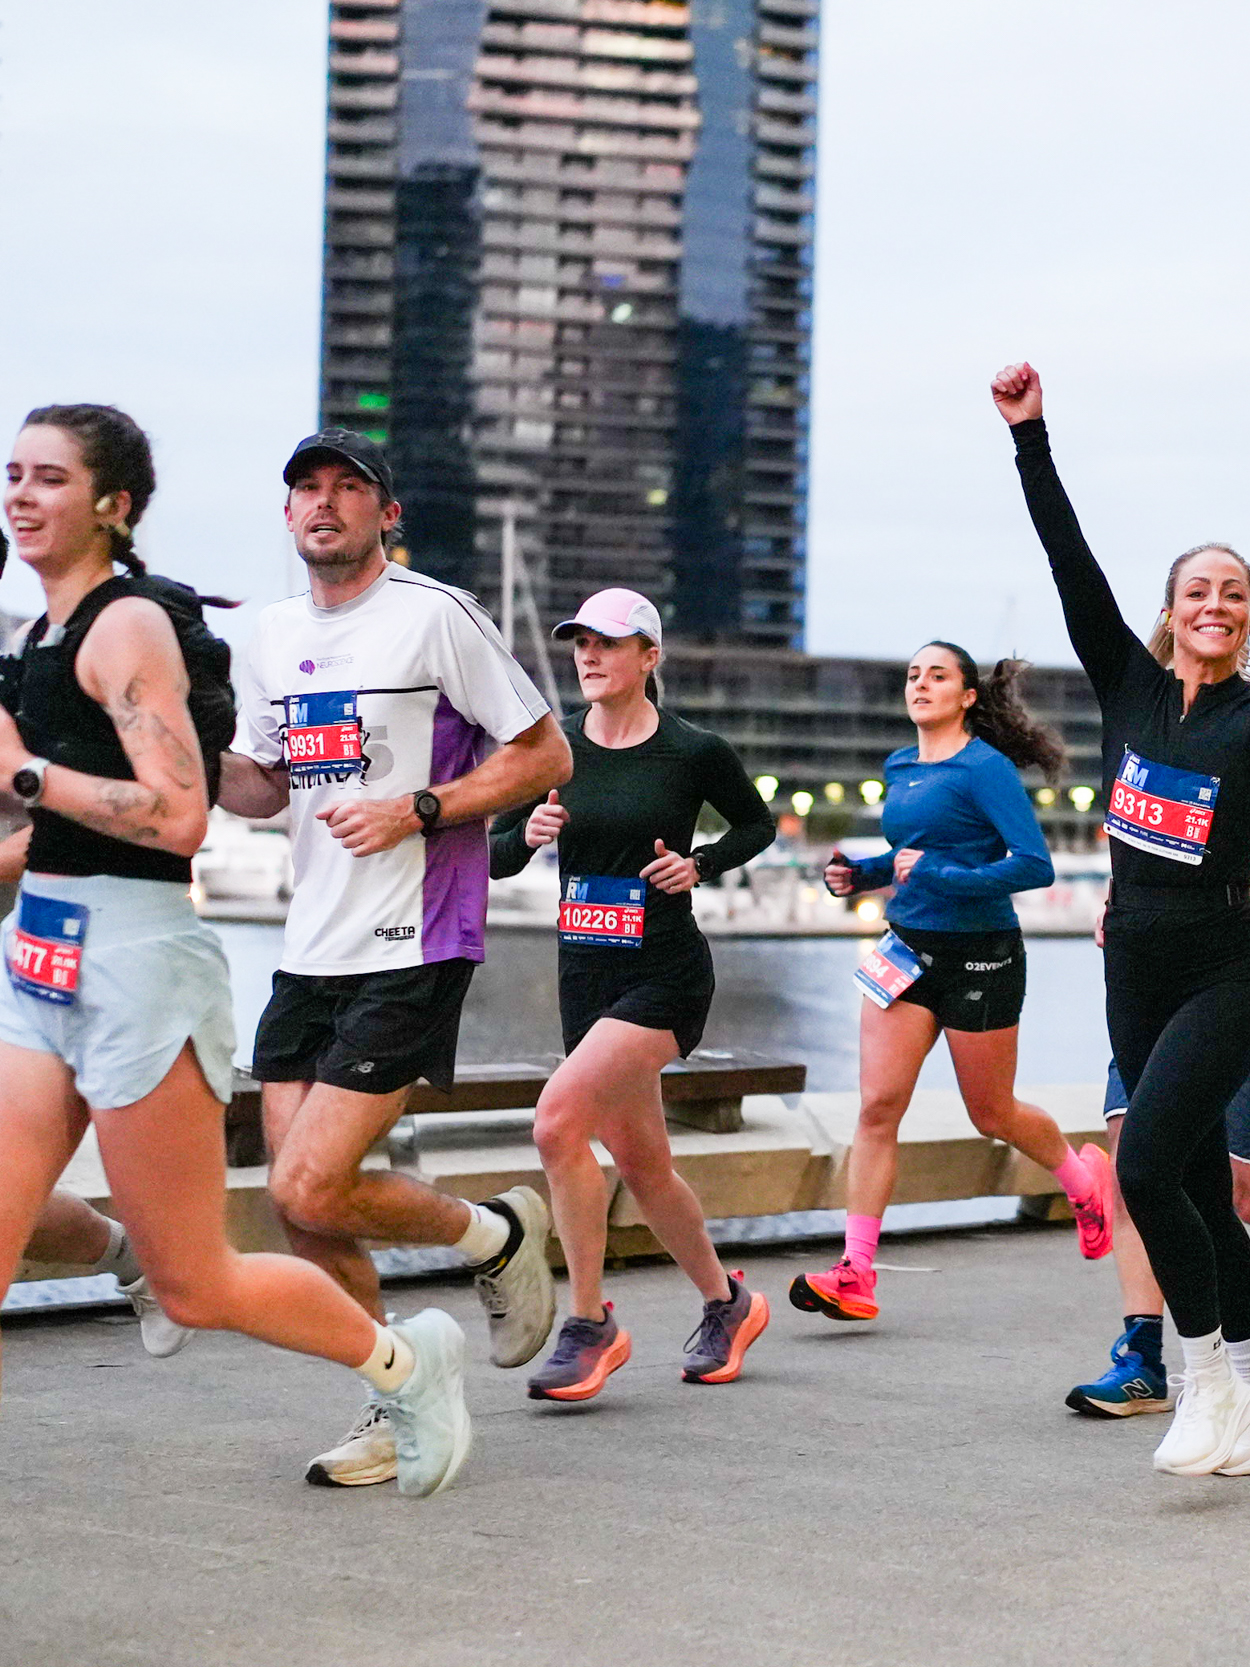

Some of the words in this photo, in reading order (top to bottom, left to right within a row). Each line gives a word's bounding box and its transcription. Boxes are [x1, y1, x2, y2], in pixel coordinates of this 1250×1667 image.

[290, 733, 324, 757] 9931
[1122, 759, 1149, 788] RM
[1114, 788, 1163, 825] 9313
[1184, 815, 1209, 827] 21.1K
[566, 882, 589, 900] RM
[563, 907, 618, 930] 10226
[622, 914, 642, 923] 21.1K
[374, 926, 415, 937] CHEETA
